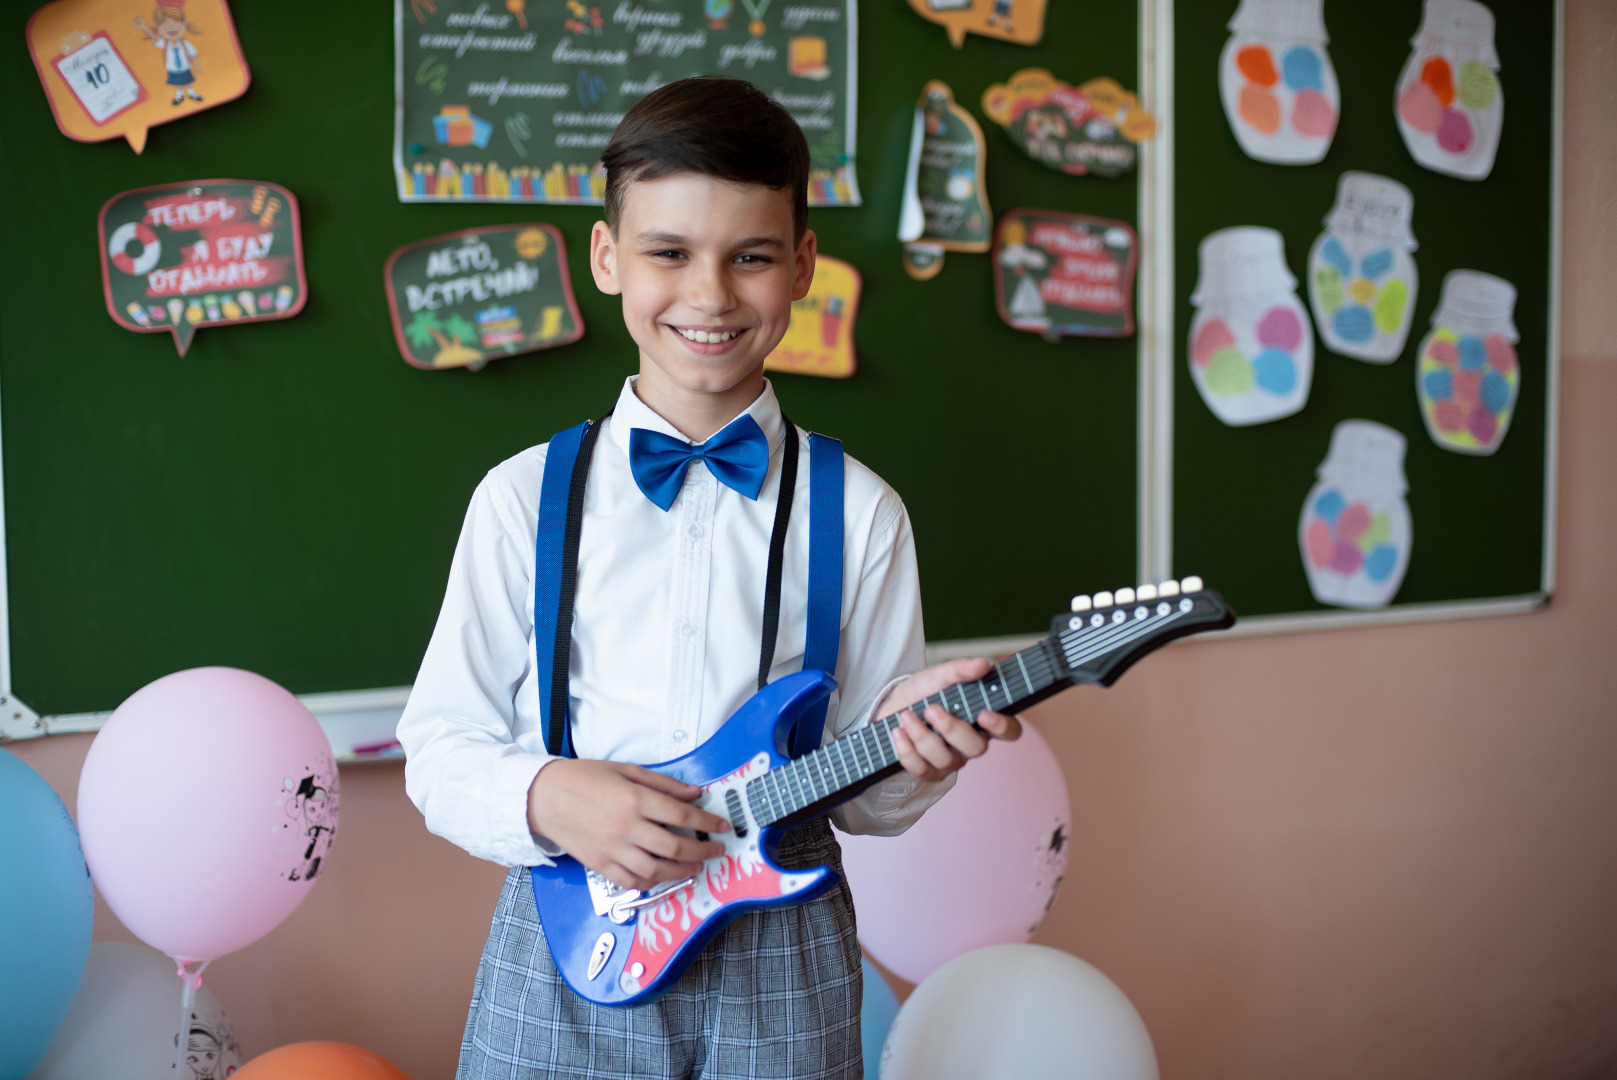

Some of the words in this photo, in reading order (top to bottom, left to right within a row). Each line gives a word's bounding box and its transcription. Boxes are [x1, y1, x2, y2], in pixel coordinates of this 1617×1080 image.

[85, 62, 110, 89] 10
[147, 198, 236, 227] ТЕПЕРЬ
[192, 239, 209, 262] Я
[216, 232, 274, 261] БУДУ
[426, 242, 499, 278] ЛЕТО,
[148, 261, 268, 294] ОТДЫХАТЬ
[405, 261, 539, 312] ВСТРЕЧАЙ!
